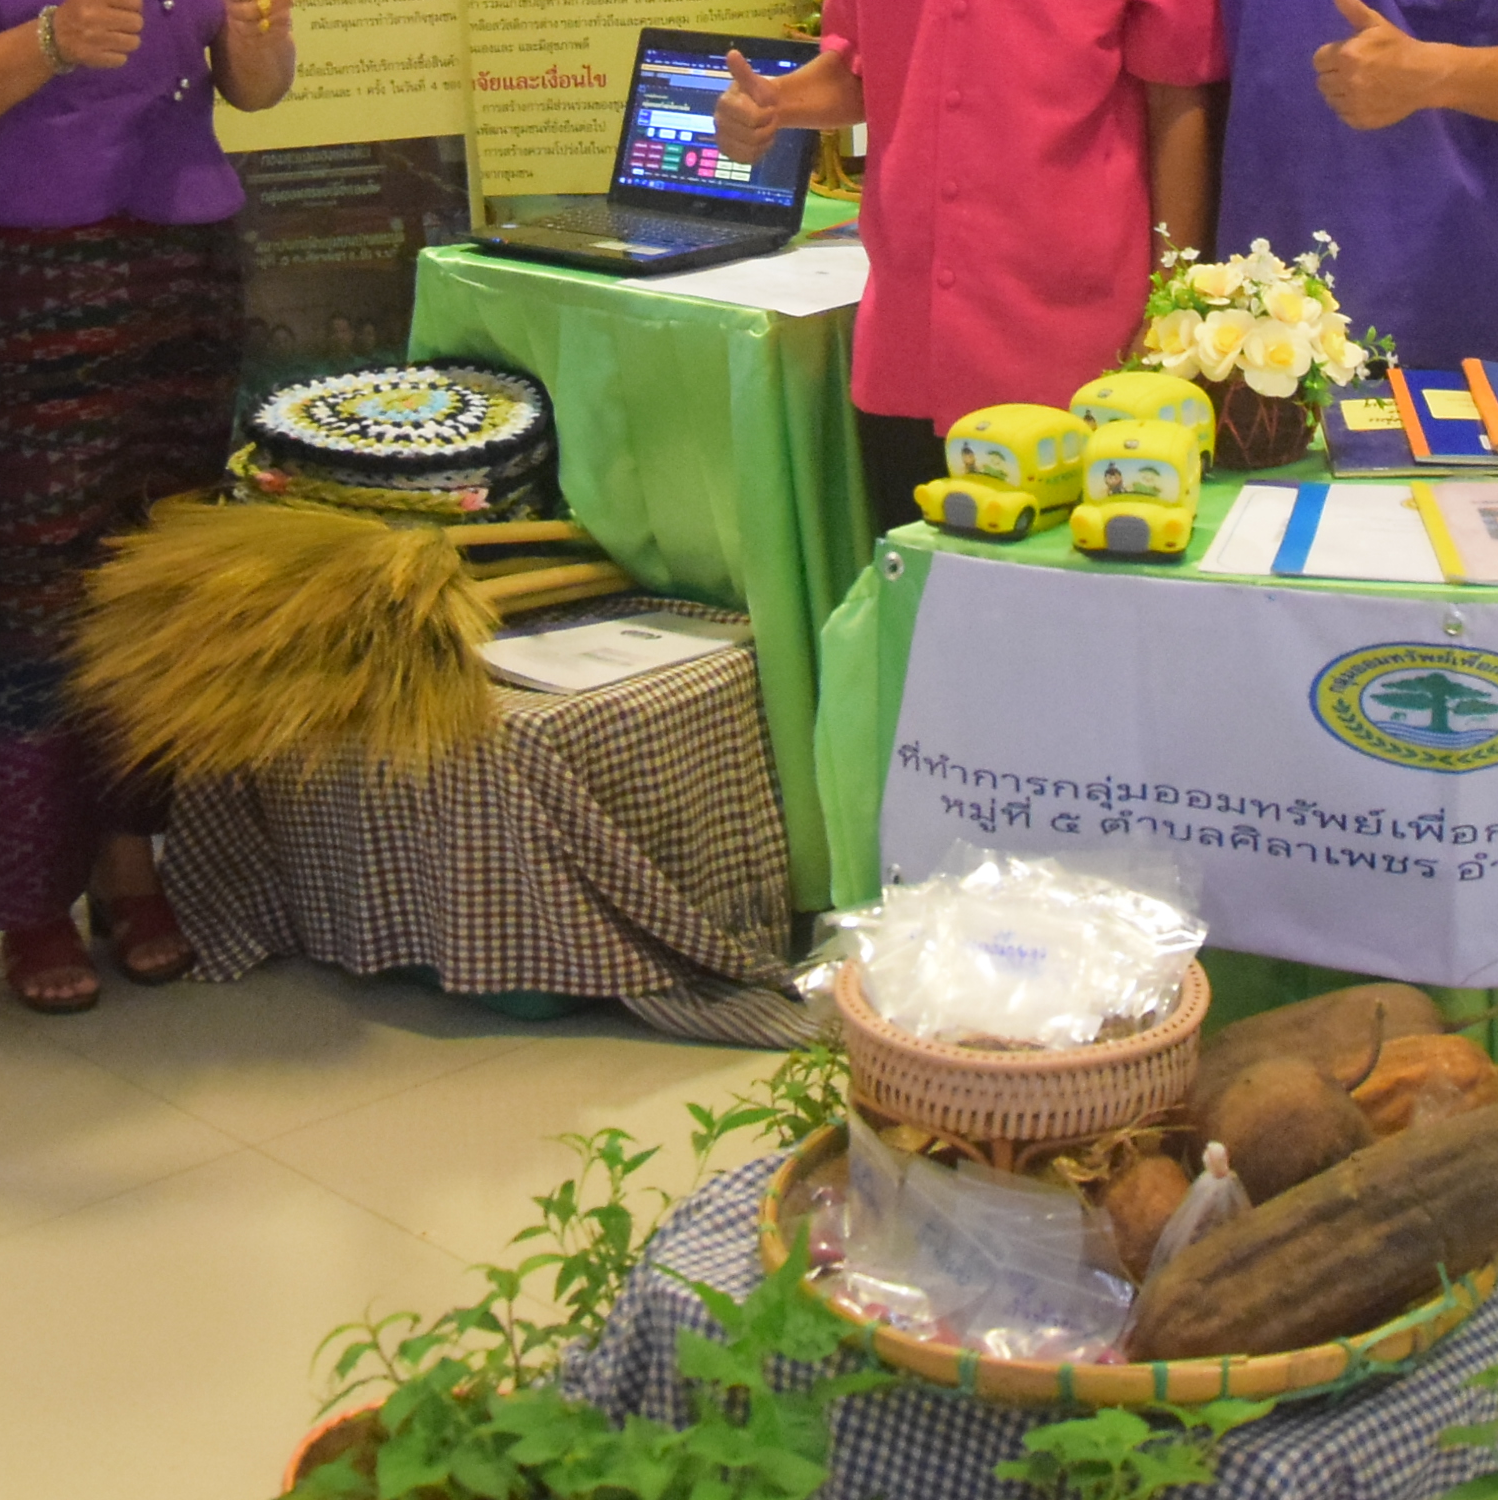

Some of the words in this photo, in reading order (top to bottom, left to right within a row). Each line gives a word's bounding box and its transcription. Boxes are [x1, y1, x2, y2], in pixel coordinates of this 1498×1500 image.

[940, 793, 1033, 834] หมู่ที่
[1051, 812, 1081, 834] ๕
[1100, 808, 1438, 881] ตำบลศิลาเพชร
